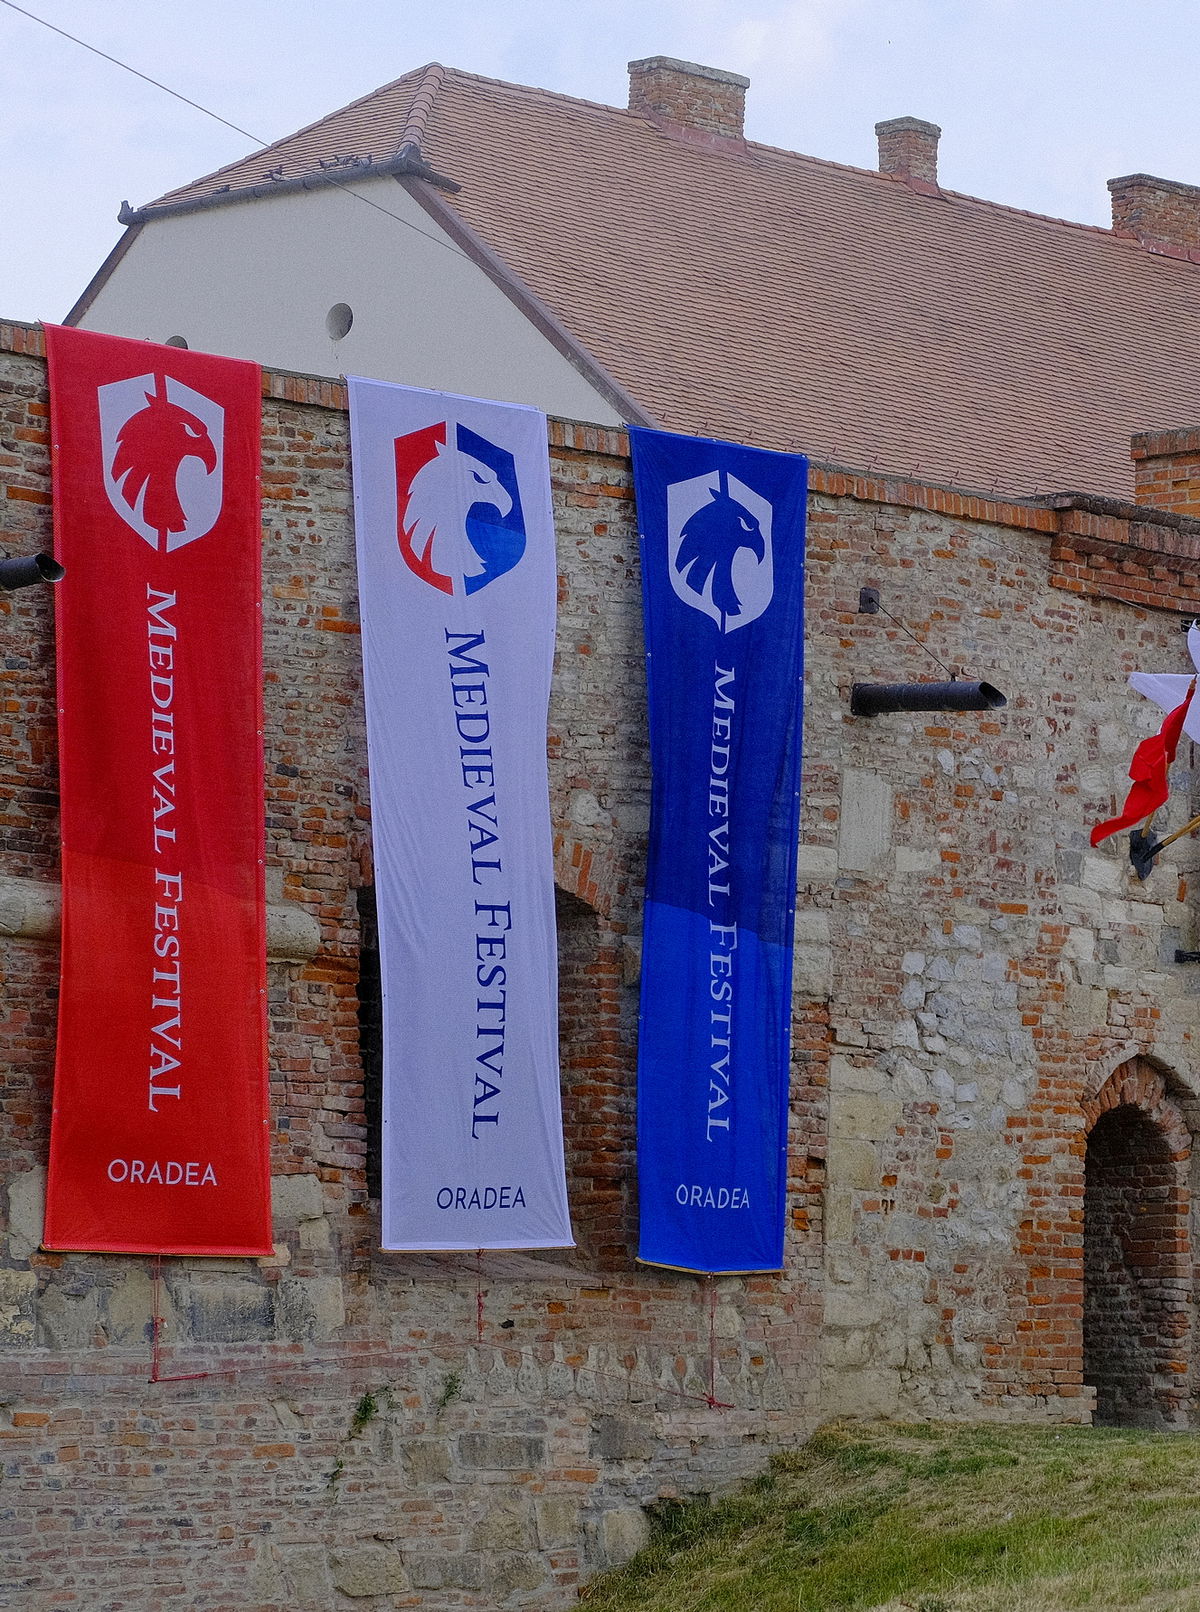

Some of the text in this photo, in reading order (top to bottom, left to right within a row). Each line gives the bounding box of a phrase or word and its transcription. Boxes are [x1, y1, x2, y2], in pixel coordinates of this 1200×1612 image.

[147, 582, 183, 1113] MEDIEVAL FESTIVAL
[444, 626, 513, 1140] MEDIEVAL FESTIVAL
[706, 660, 738, 1142] MEDIEVAL FESTIVAL
[107, 1159, 218, 1186] ORADEA
[436, 1183, 527, 1210] ORADEA
[676, 1184, 750, 1209] ORADEA
